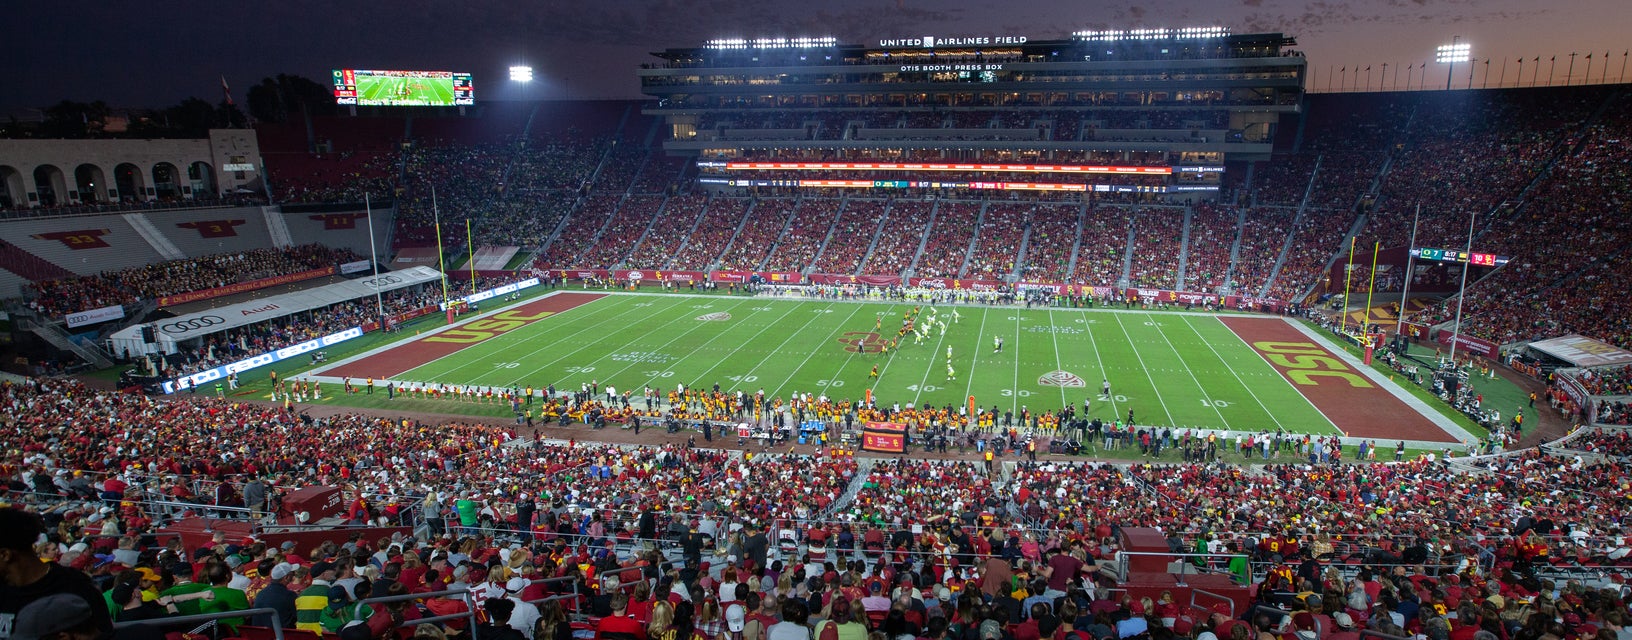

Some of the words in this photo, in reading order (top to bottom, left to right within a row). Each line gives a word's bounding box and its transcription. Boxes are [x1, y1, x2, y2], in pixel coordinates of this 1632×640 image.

[995, 36, 1027, 44] FIELD
[66, 235, 96, 244] 33
[241, 303, 280, 316] Audi
[420, 310, 556, 343] USC
[1253, 341, 1375, 389] USC
[566, 366, 596, 374] 20
[729, 375, 759, 383] 40
[816, 379, 845, 388] 50
[906, 384, 936, 392] 40
[1000, 389, 1031, 397] 30
[1200, 399, 1229, 408] 10
[1270, 541, 1279, 552] 9
